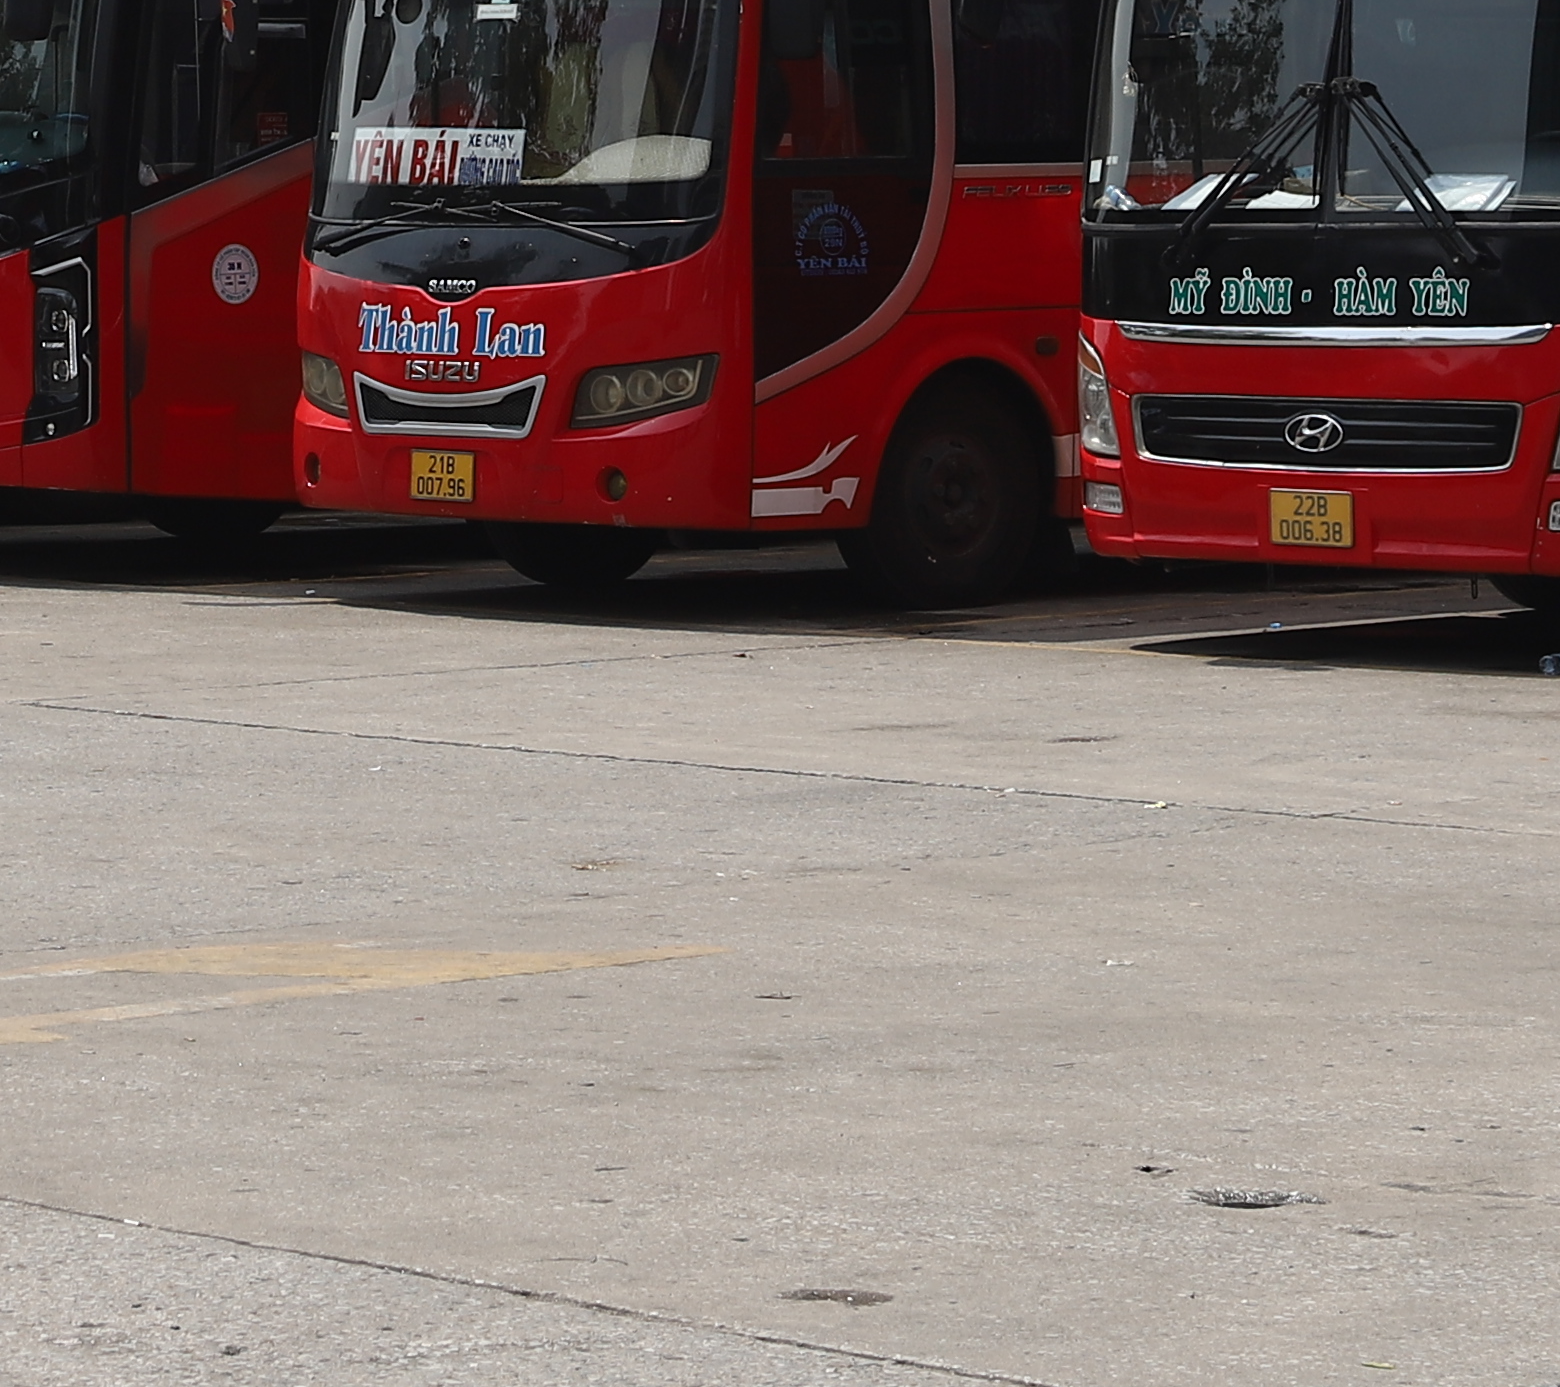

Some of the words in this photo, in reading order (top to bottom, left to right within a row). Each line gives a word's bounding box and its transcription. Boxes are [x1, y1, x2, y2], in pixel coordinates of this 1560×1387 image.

[467, 133, 482, 148] XE
[485, 133, 515, 152] CHẠY
[355, 130, 405, 185] YÊN
[408, 130, 460, 185] BÁI
[428, 279, 477, 294] SAMCO
[1169, 267, 1211, 315] MỸ
[1220, 266, 1293, 315] ĐÌNH
[1333, 266, 1397, 316] HÀM
[1409, 266, 1469, 317] YÊN
[358, 301, 460, 355] Thành
[472, 307, 546, 360] Lan
[404, 359, 480, 382] ISUZU
[428, 454, 456, 475] 21B
[416, 476, 466, 498] 007.96
[1293, 494, 1328, 517] 22B
[1279, 519, 1343, 543] 006.38
